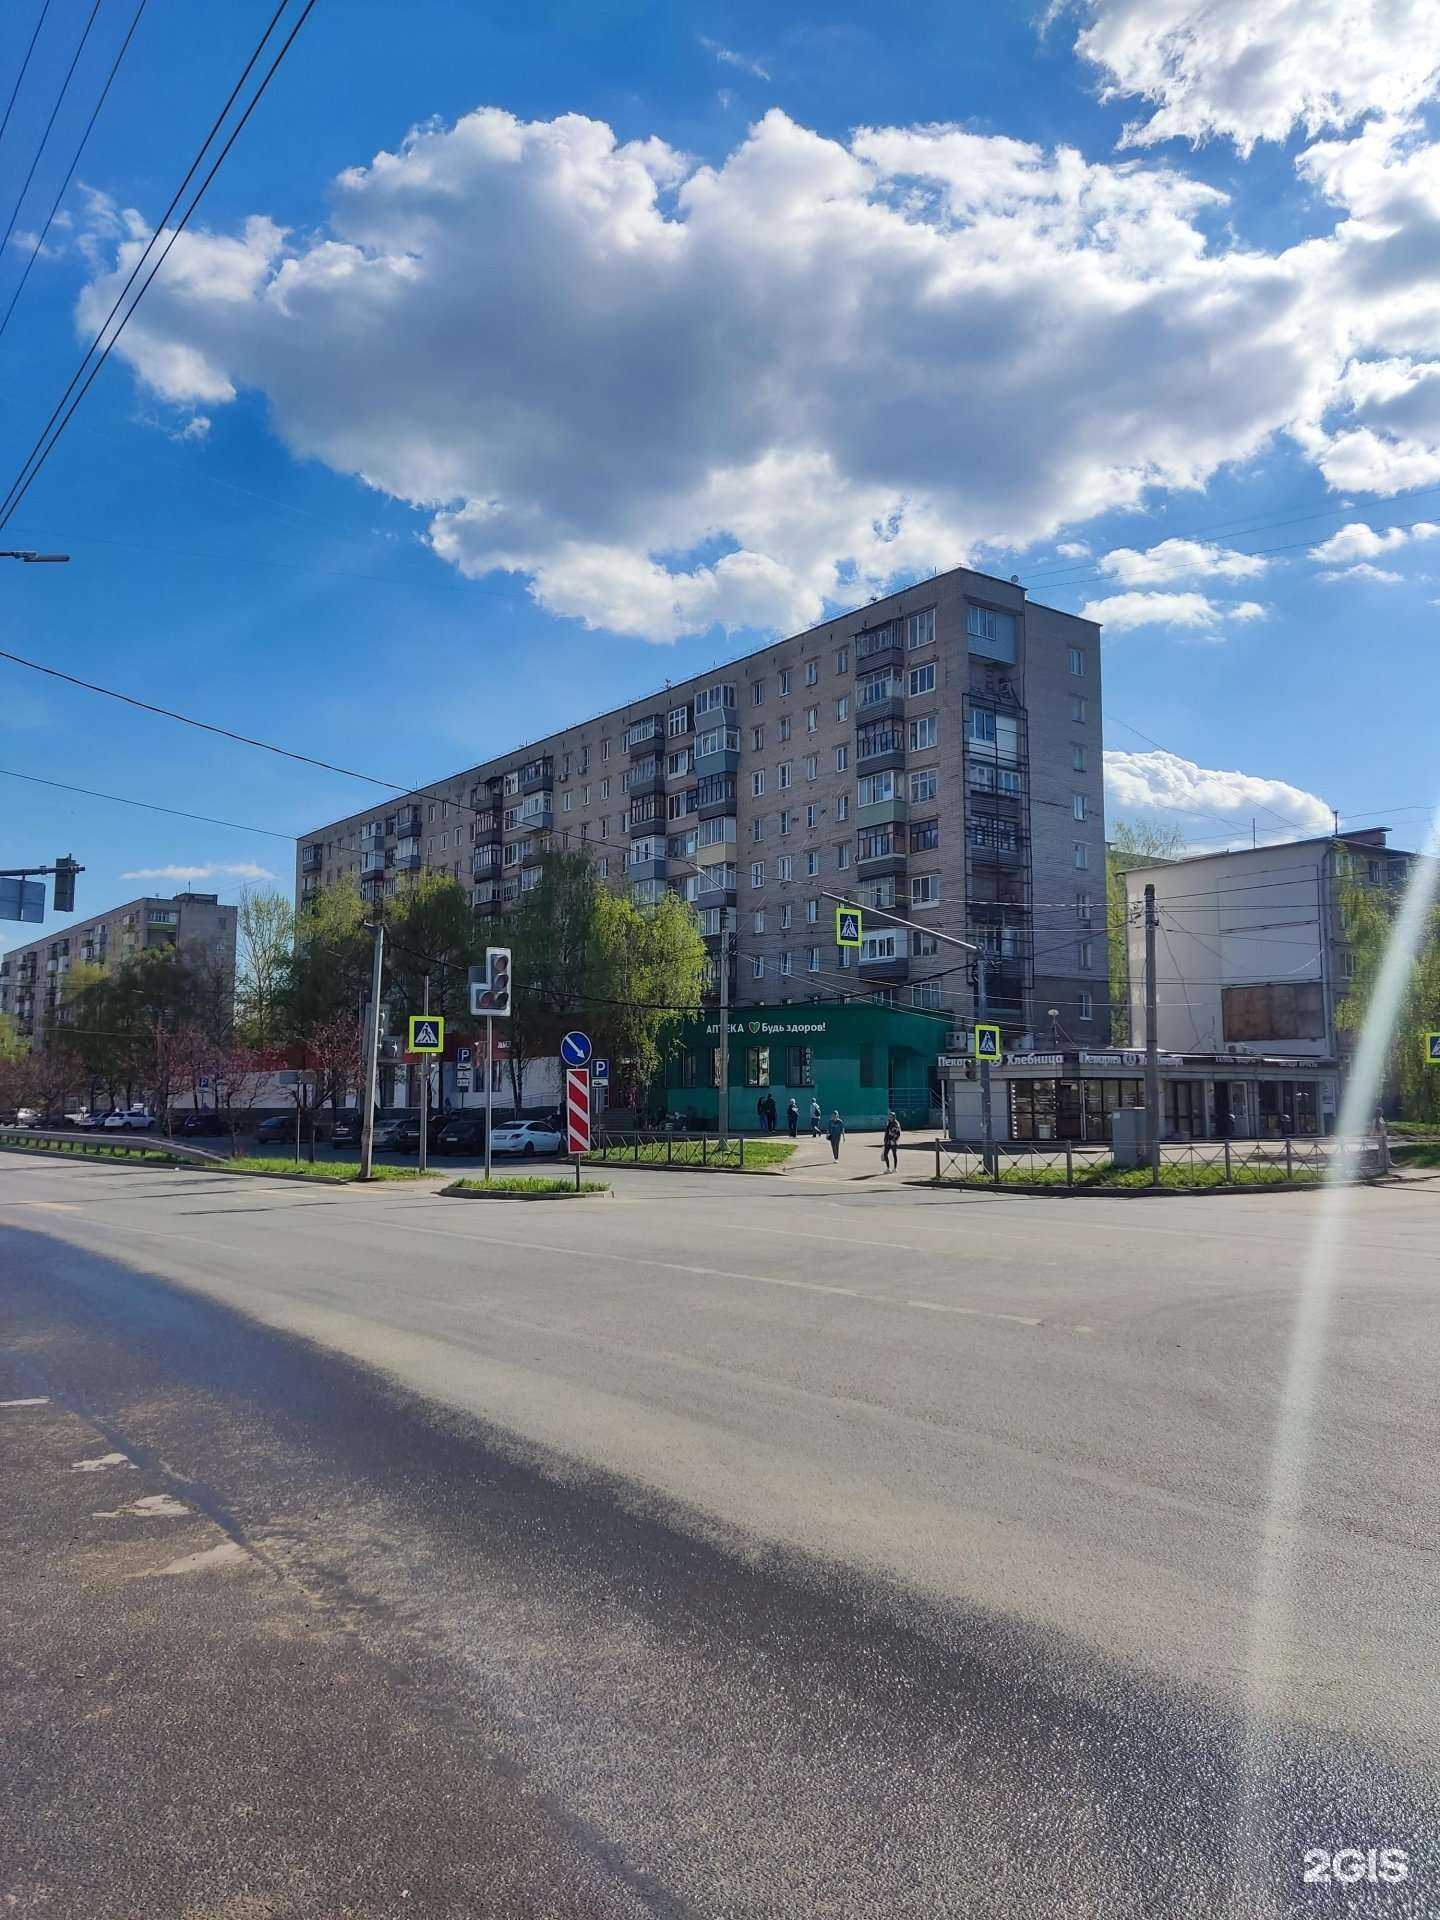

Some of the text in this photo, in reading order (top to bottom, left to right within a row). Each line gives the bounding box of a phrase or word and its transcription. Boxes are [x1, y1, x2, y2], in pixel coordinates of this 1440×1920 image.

[761, 1021, 827, 1034] Будь здоров!
[1006, 1053, 1064, 1066] Хлебница
[596, 1061, 606, 1076] P
